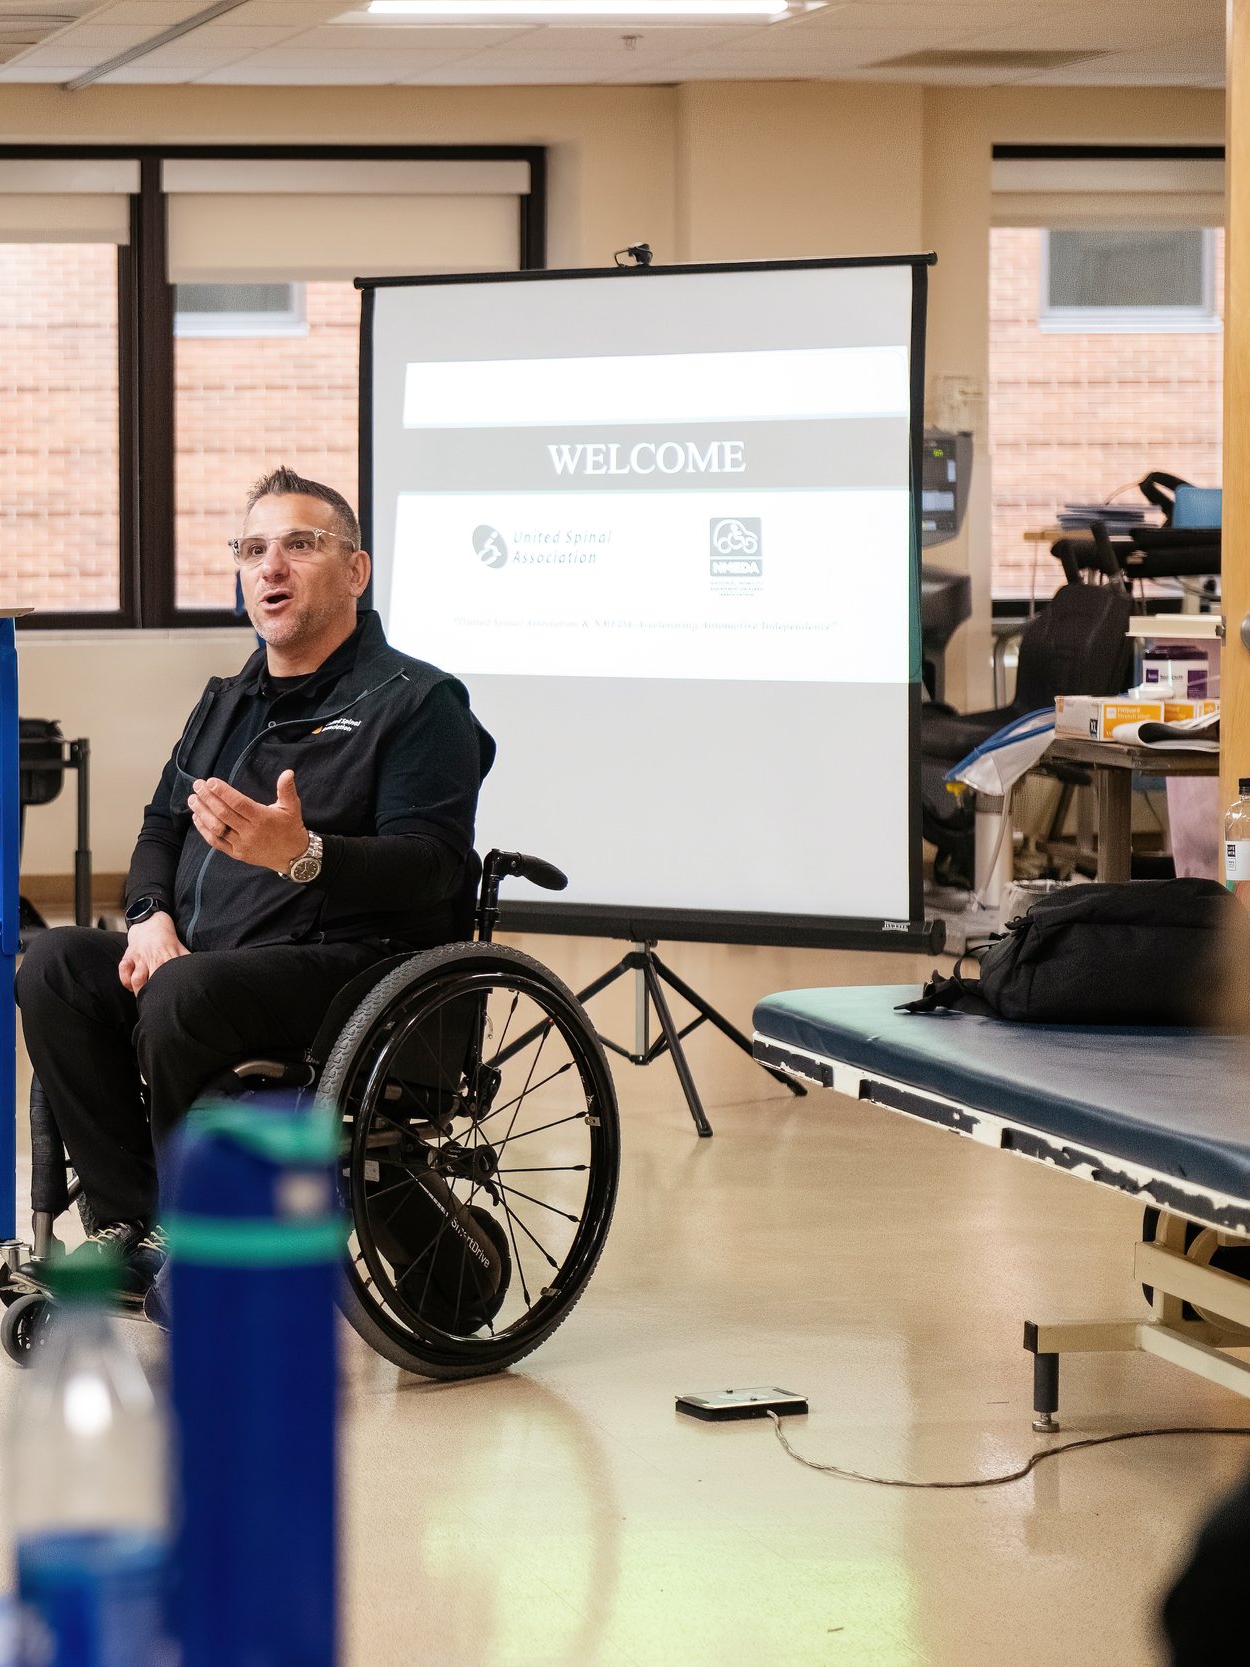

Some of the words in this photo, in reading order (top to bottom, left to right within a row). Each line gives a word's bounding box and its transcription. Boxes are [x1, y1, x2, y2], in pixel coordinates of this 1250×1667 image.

[547, 440, 746, 475] WELCOME
[513, 529, 561, 544] United
[565, 529, 612, 547] Spinal
[512, 550, 597, 564] Association
